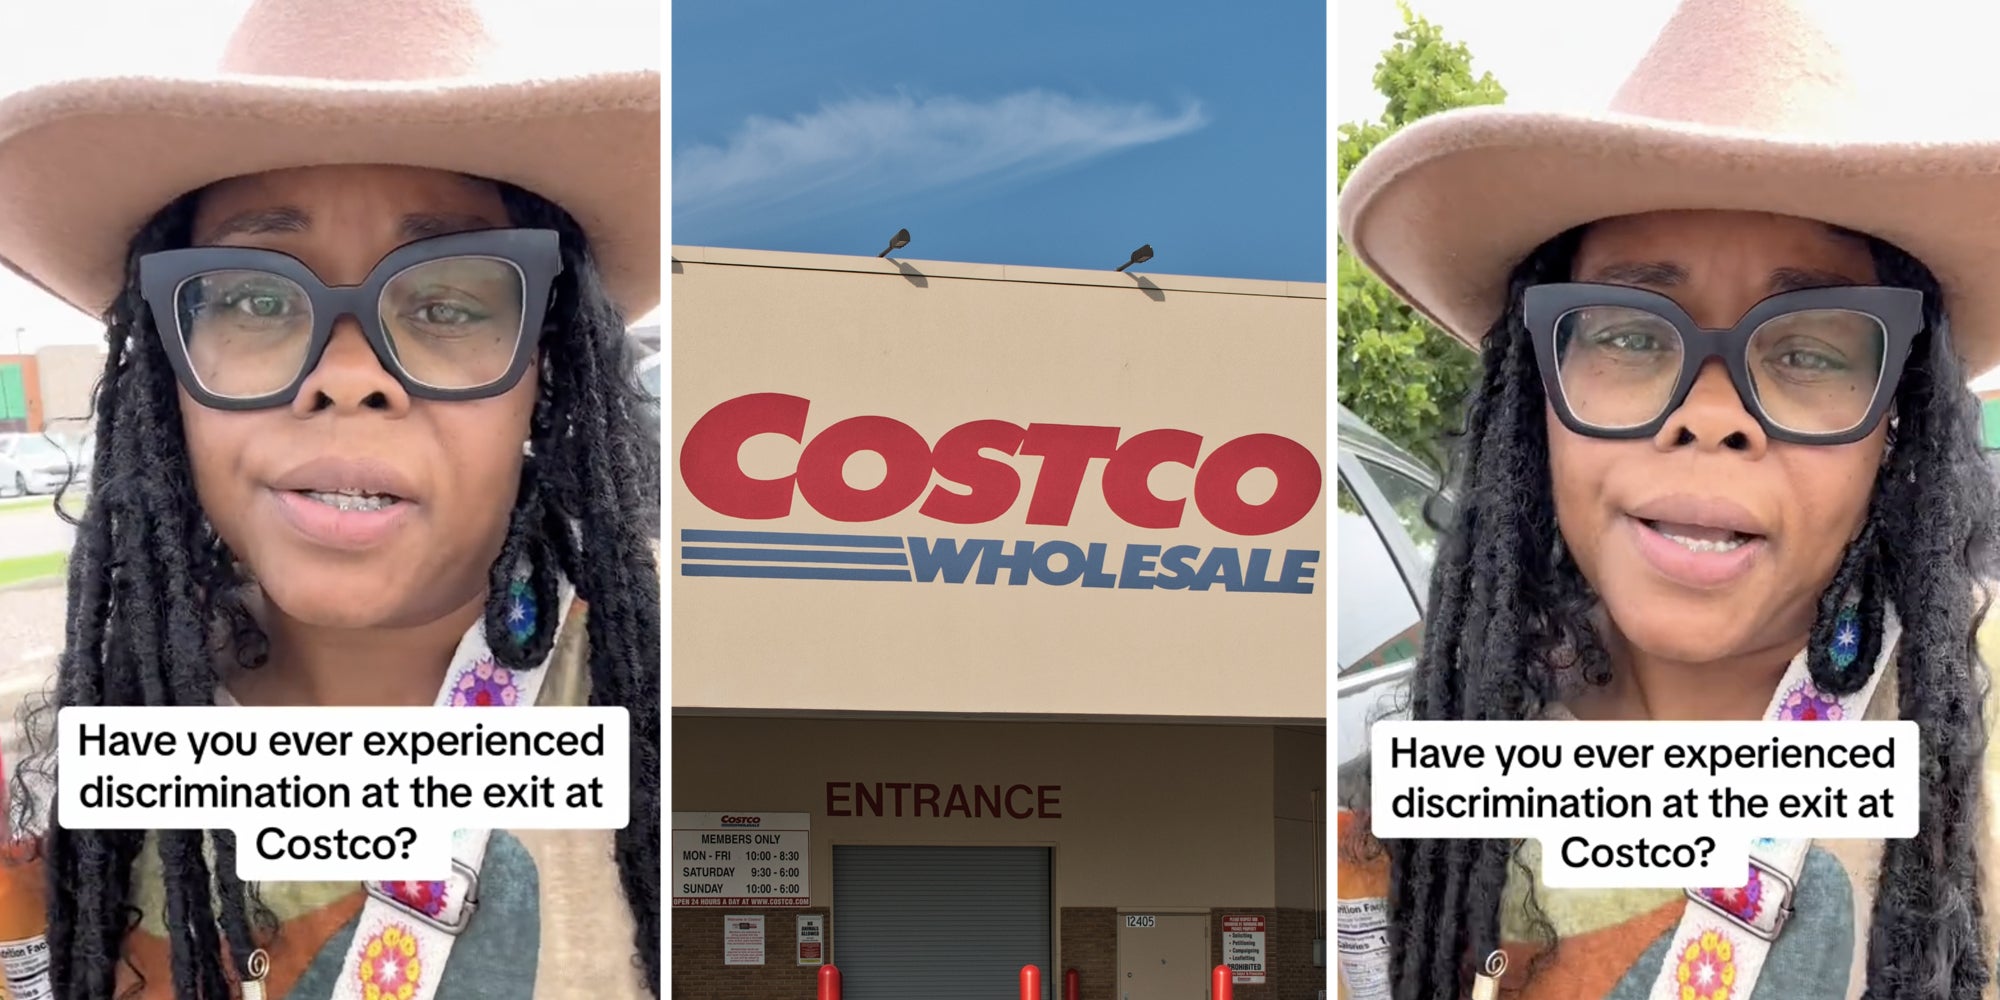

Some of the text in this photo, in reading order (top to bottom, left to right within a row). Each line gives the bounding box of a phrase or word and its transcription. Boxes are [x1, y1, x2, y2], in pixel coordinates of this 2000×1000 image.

[680, 392, 1322, 536] COSTCO
[907, 536, 1321, 594] WHOLESALE
[825, 781, 1062, 819] ENTRANCE
[721, 815, 760, 823] COSTCO
[701, 834, 781, 845] MEMBERS ONLY
[683, 850, 706, 861] MON
[715, 851, 731, 861] FRI
[746, 851, 771, 861] 10:00
[779, 851, 800, 861] 8:30
[683, 867, 735, 878] SATURDAY
[751, 867, 771, 878] 9:30
[779, 867, 800, 878] 6:00
[683, 883, 724, 894] SUNDAY
[746, 883, 771, 894] 10:00
[779, 883, 800, 894] 6:00
[1127, 917, 1154, 927] 12405
